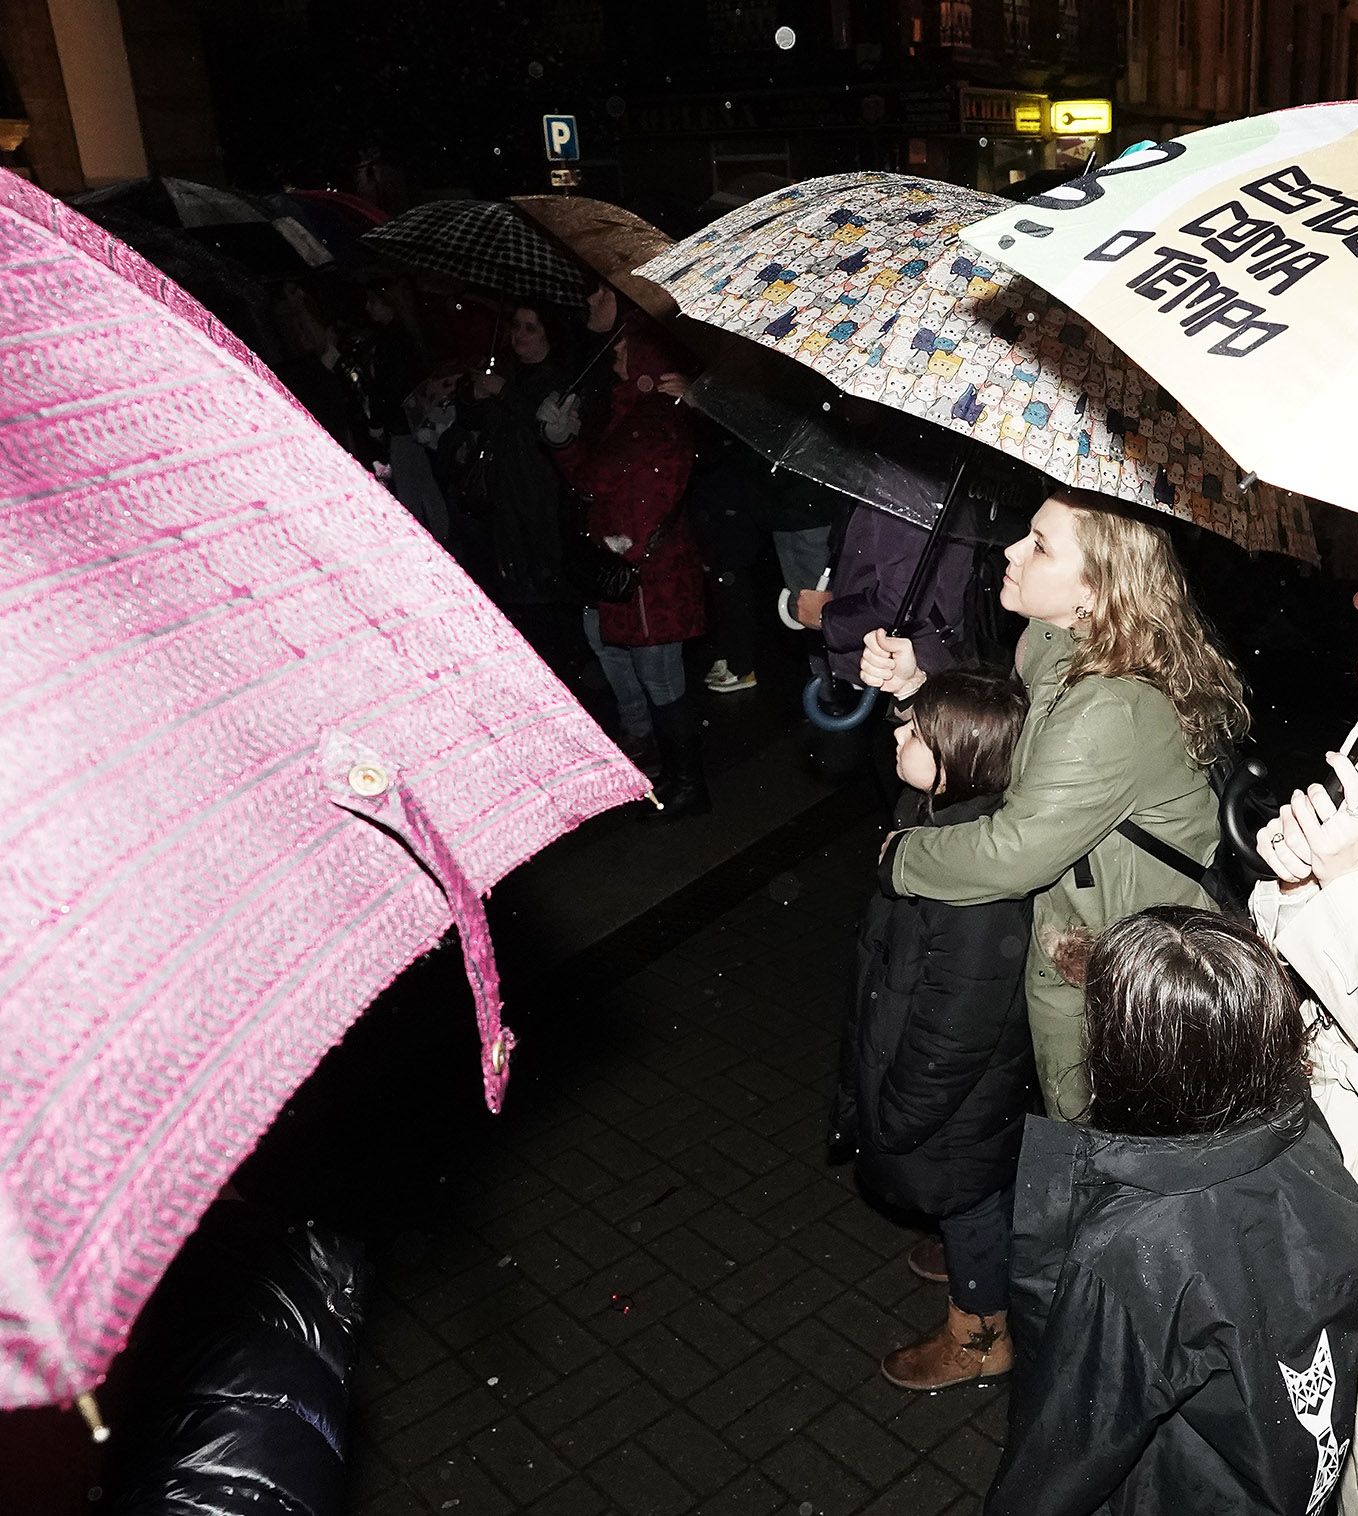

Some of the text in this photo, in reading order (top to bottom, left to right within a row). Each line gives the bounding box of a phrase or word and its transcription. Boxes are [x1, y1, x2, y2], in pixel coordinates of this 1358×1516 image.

[551, 121, 571, 155] P
[1083, 229, 1290, 358] O TEMPO
[1179, 201, 1330, 297] COMA
